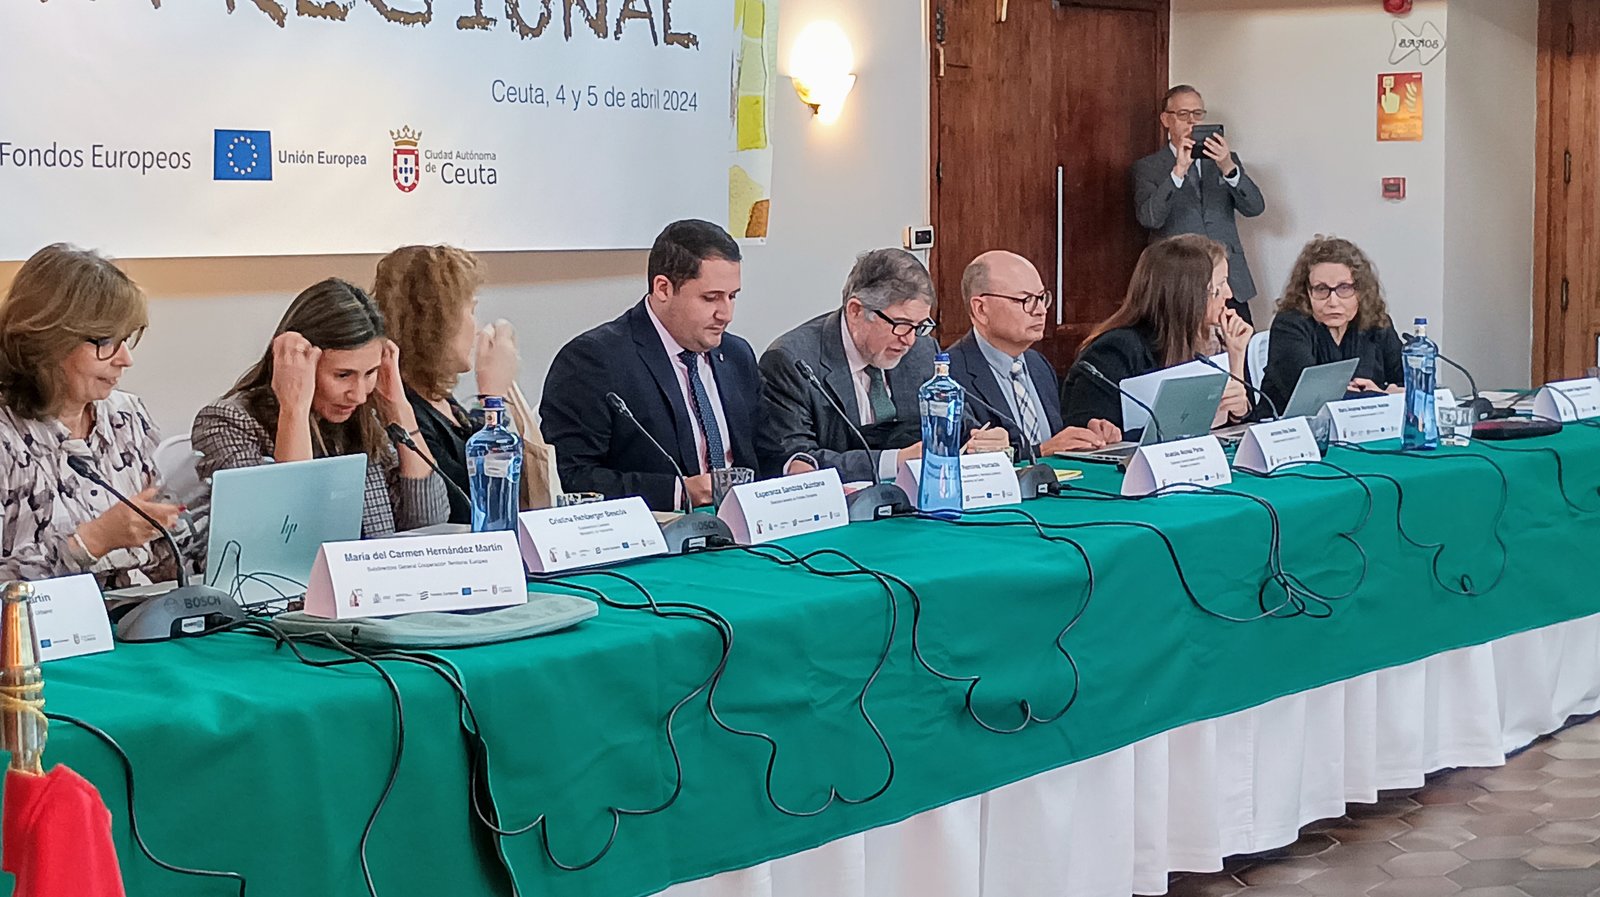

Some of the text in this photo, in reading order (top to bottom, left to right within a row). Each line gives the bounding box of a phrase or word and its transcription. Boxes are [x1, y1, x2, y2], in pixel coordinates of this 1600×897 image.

[226, 0, 699, 50] ONAL
[491, 79, 698, 112] Ceuta, 4 y 5 de abril 2024
[0, 142, 192, 176] Fondos Europeos
[278, 149, 367, 168] Unión Europea
[424, 149, 497, 161] Ciudad Autónoma
[425, 162, 436, 173] de
[440, 162, 497, 185] Ceuta
[280, 514, 298, 544] hp
[344, 542, 504, 563] María del Carmen Hernández Martín
[183, 595, 222, 609] BOSCH
